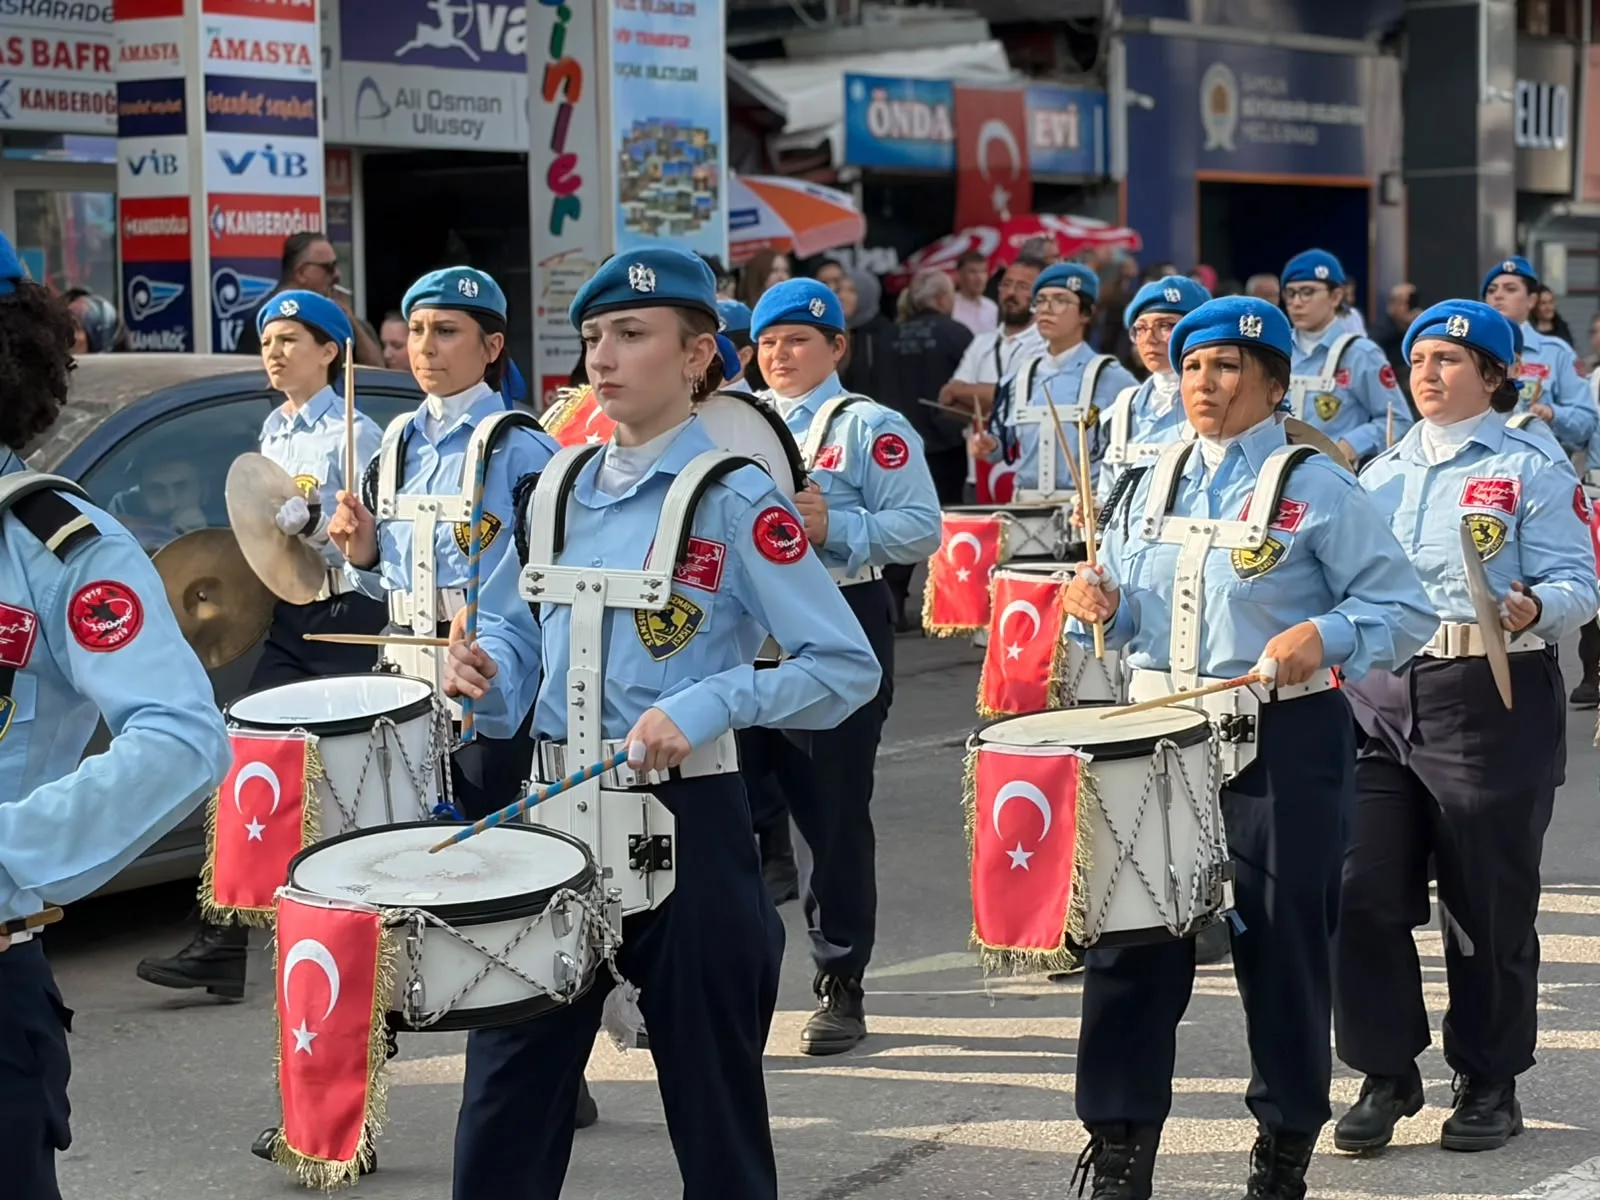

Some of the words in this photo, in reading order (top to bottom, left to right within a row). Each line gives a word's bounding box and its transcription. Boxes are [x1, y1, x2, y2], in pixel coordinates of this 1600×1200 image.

[0, 36, 24, 66] S
[31, 38, 112, 73] BAFR
[207, 36, 312, 66] AMASYA
[427, 89, 502, 115] Osman
[538, 0, 583, 237] inler
[1515, 80, 1569, 150] ELLO
[412, 112, 485, 141] Ulusoy
